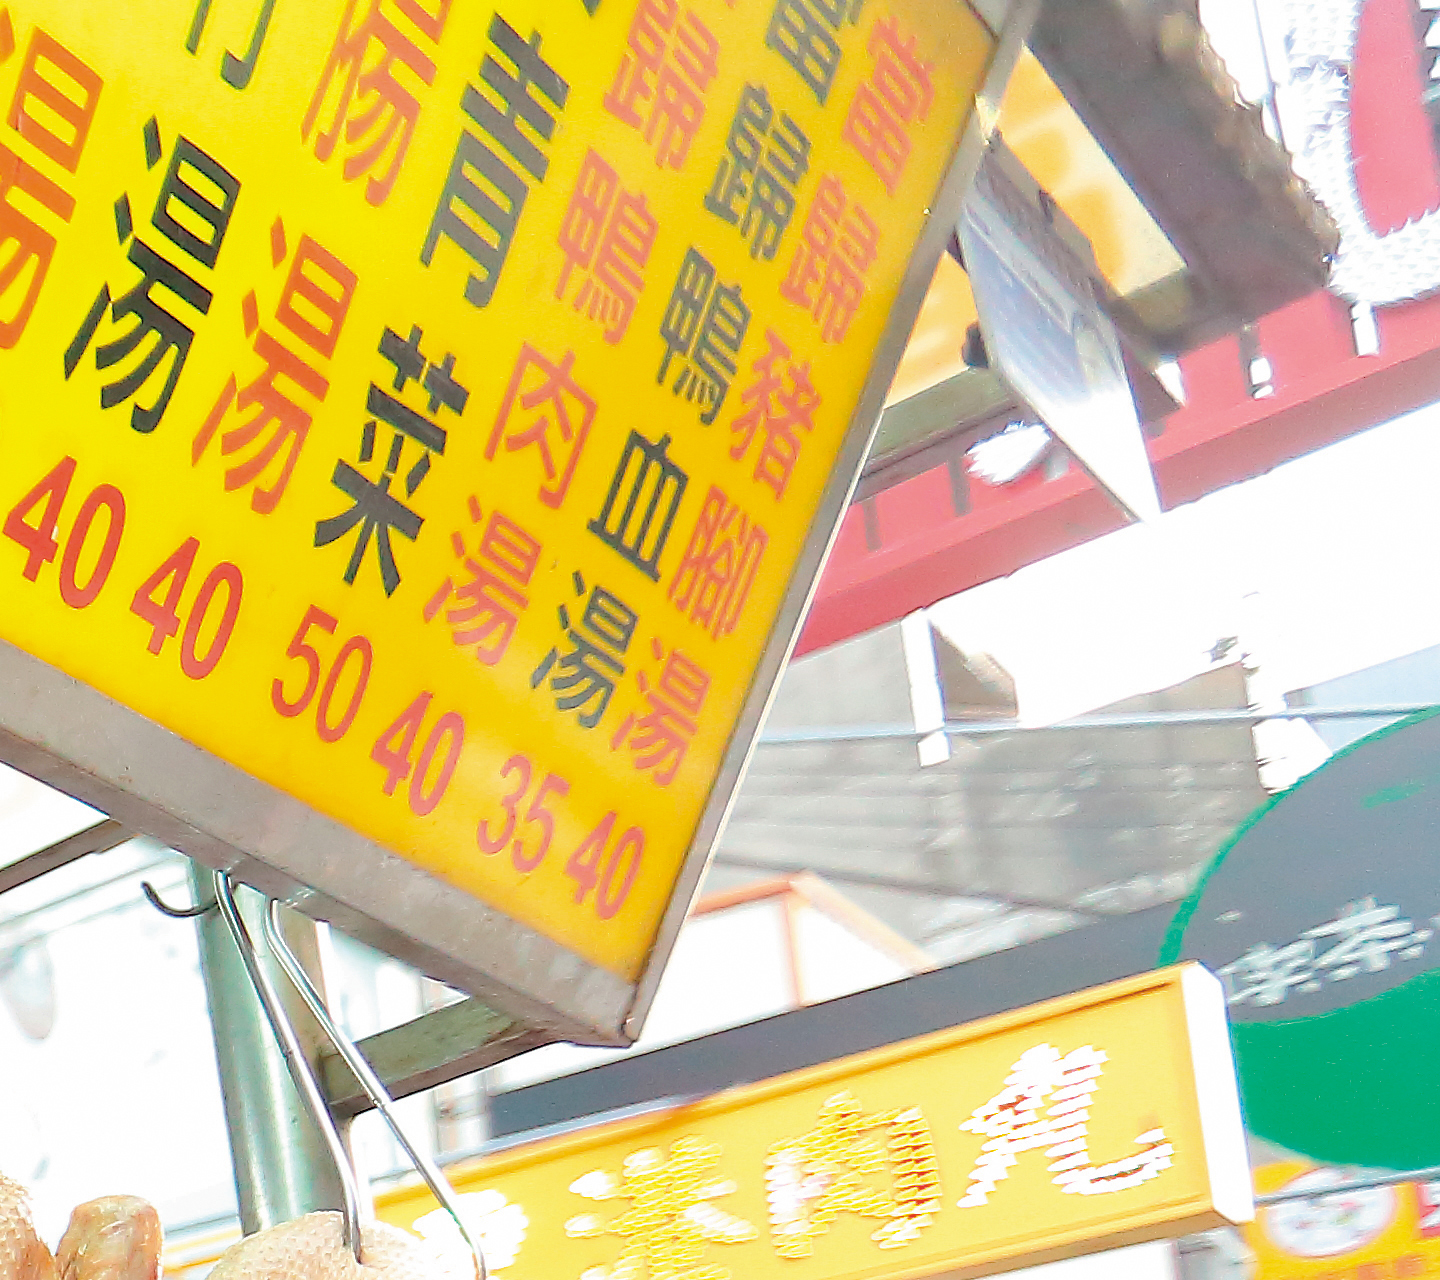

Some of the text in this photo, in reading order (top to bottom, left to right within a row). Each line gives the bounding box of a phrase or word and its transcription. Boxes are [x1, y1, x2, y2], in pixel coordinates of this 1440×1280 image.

[2, 457, 127, 610] 40
[130, 536, 244, 680] 40
[271, 604, 372, 743] 50
[370, 690, 464, 817] 40
[476, 754, 572, 874] 35
[563, 810, 644, 920] 40
